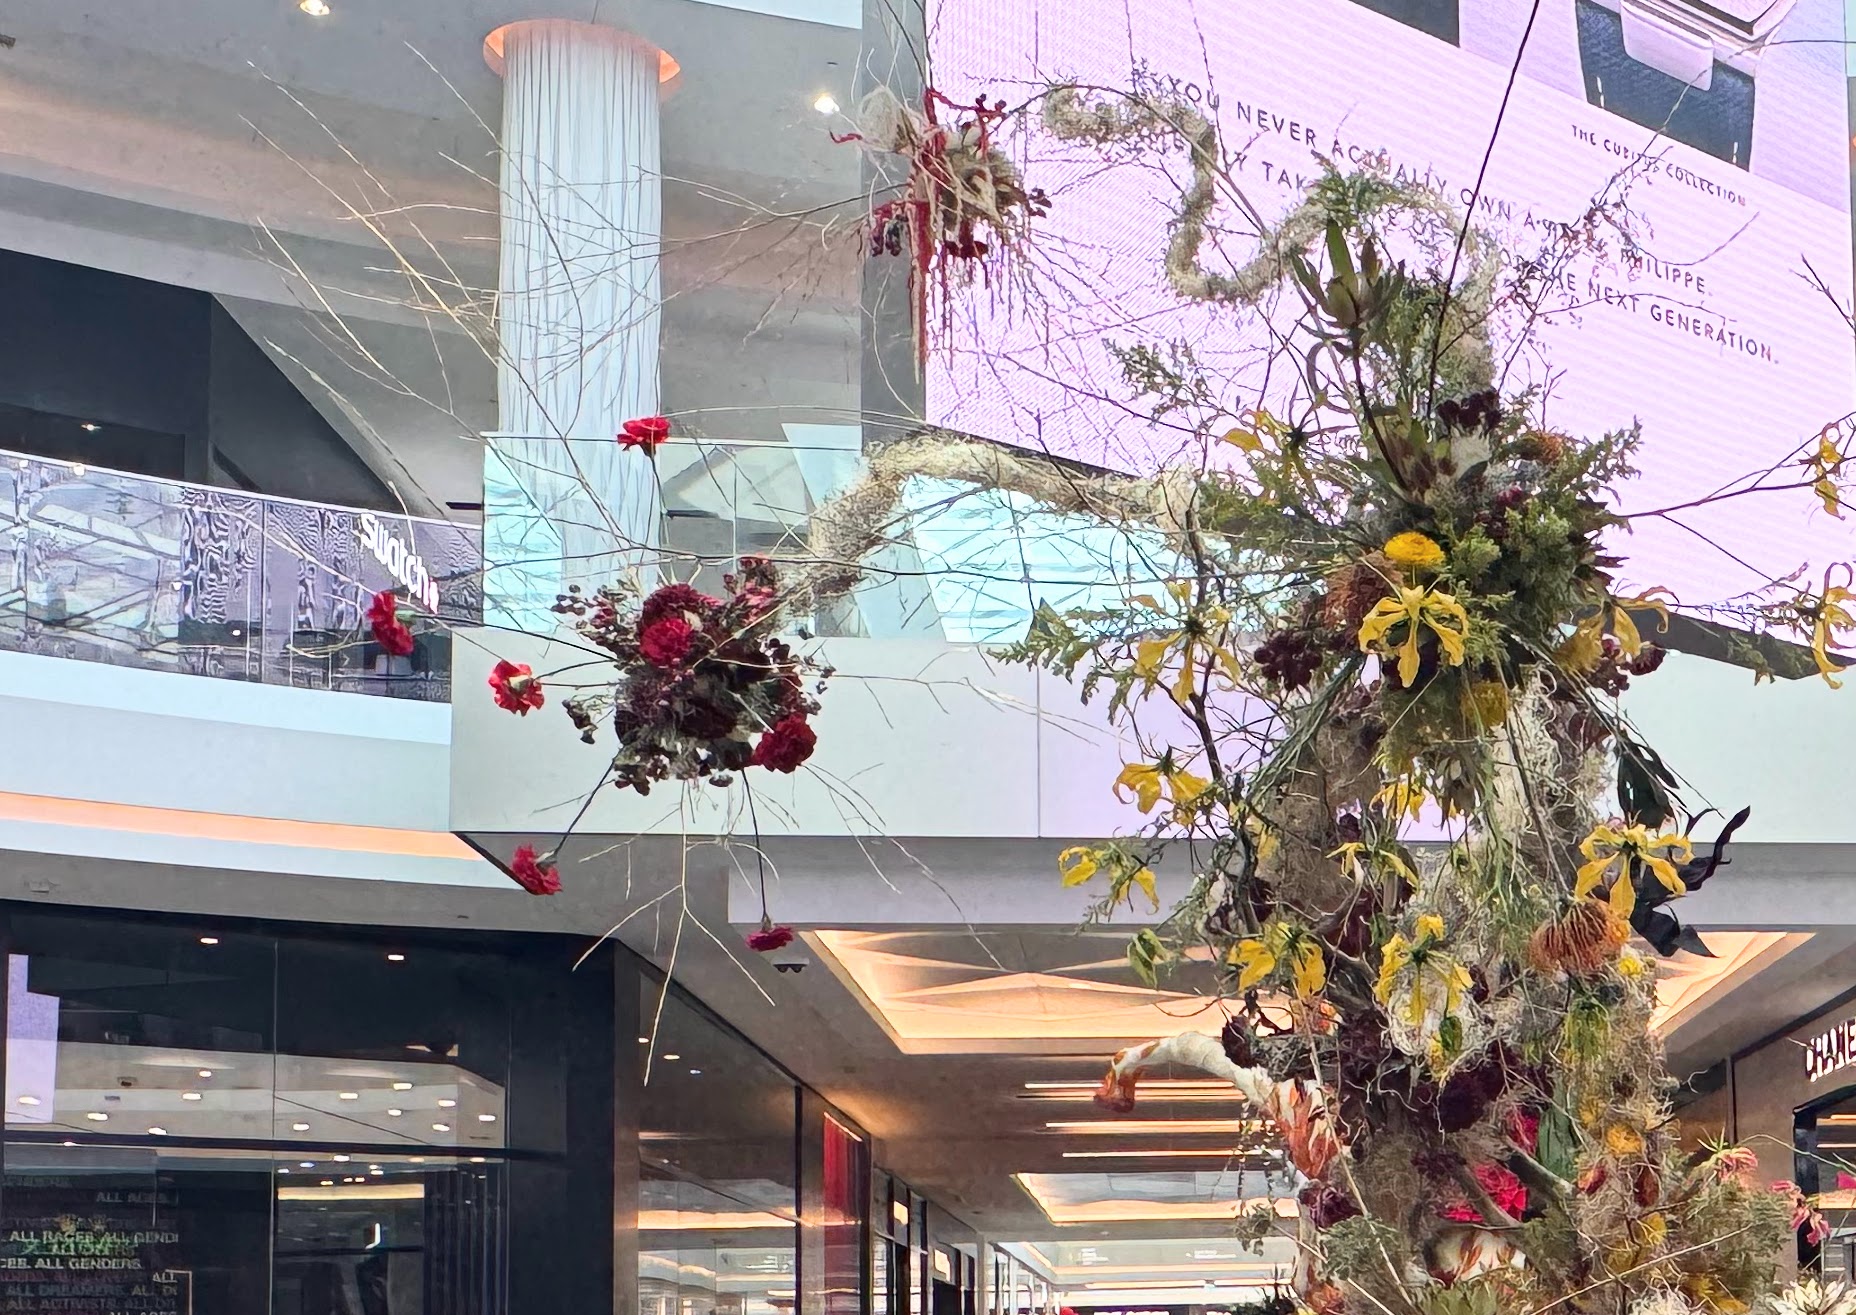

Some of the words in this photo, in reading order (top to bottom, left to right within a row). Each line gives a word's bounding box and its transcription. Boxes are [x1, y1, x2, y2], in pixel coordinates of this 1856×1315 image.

[1237, 101, 1317, 149] NEVER
[1571, 125, 1597, 146] THE
[1665, 163, 1747, 207] COLLECTION
[1588, 277, 1640, 313] NEXT
[35, 1258, 64, 1269] ALL
